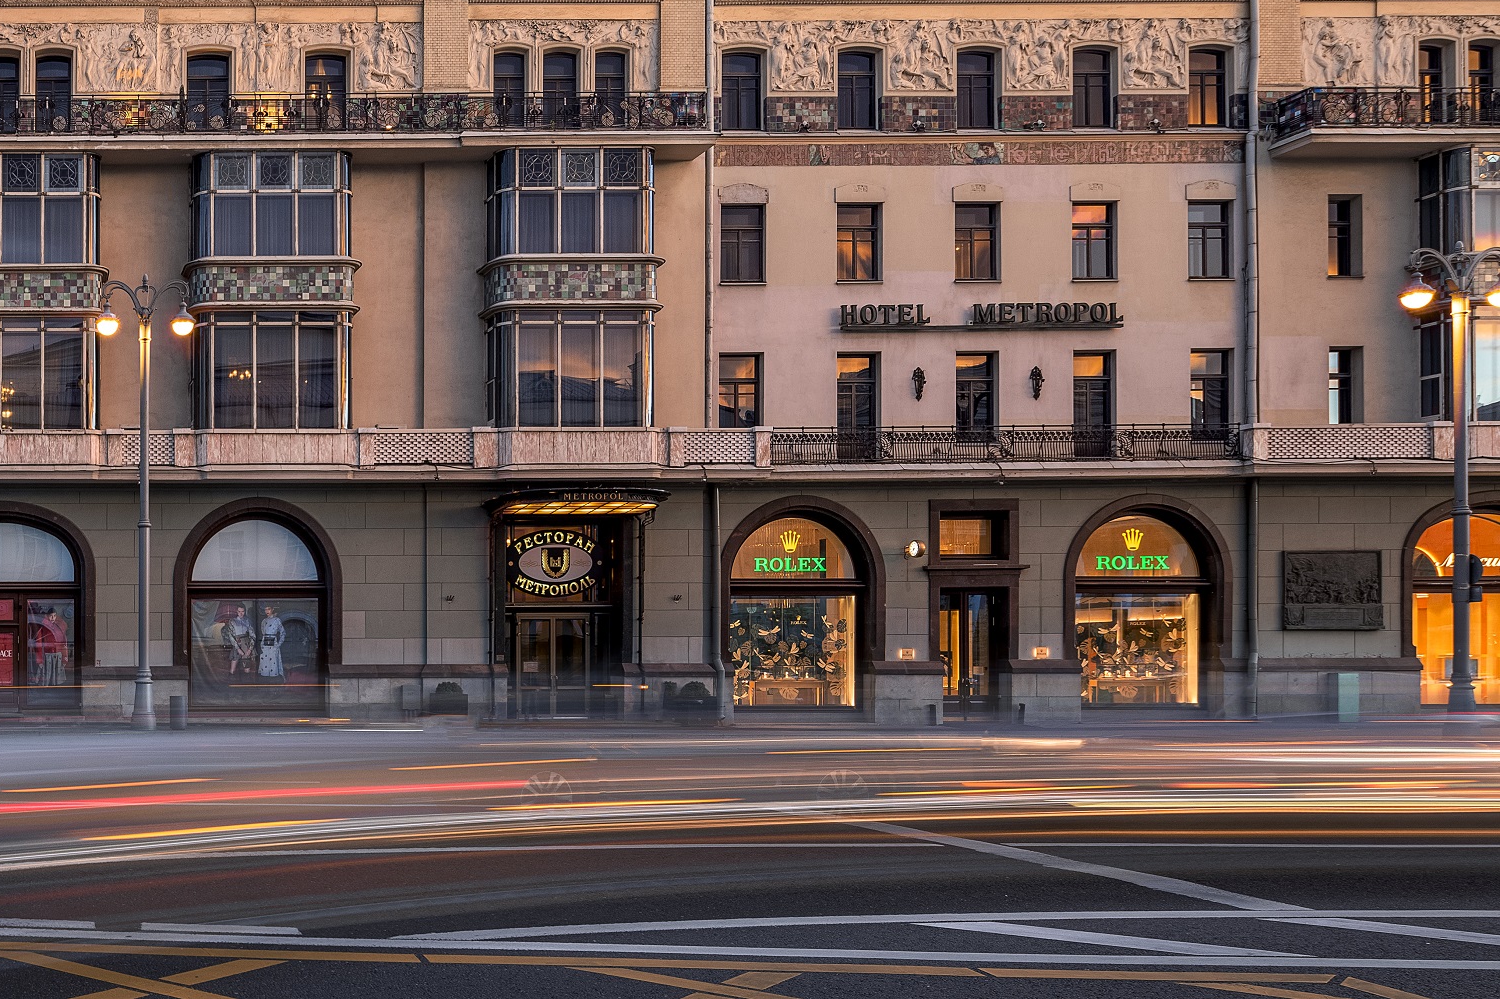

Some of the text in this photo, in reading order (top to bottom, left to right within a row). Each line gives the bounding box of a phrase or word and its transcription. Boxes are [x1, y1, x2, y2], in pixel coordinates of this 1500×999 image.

[839, 302, 1124, 326] HOTEL METROPOL
[563, 492, 624, 500] METROPOL
[514, 531, 595, 555] РЕСТОРАН
[753, 557, 827, 572] ROLEX
[1095, 555, 1170, 570] ROLEX
[514, 574, 596, 597] МЕТРОПОЛЬ
